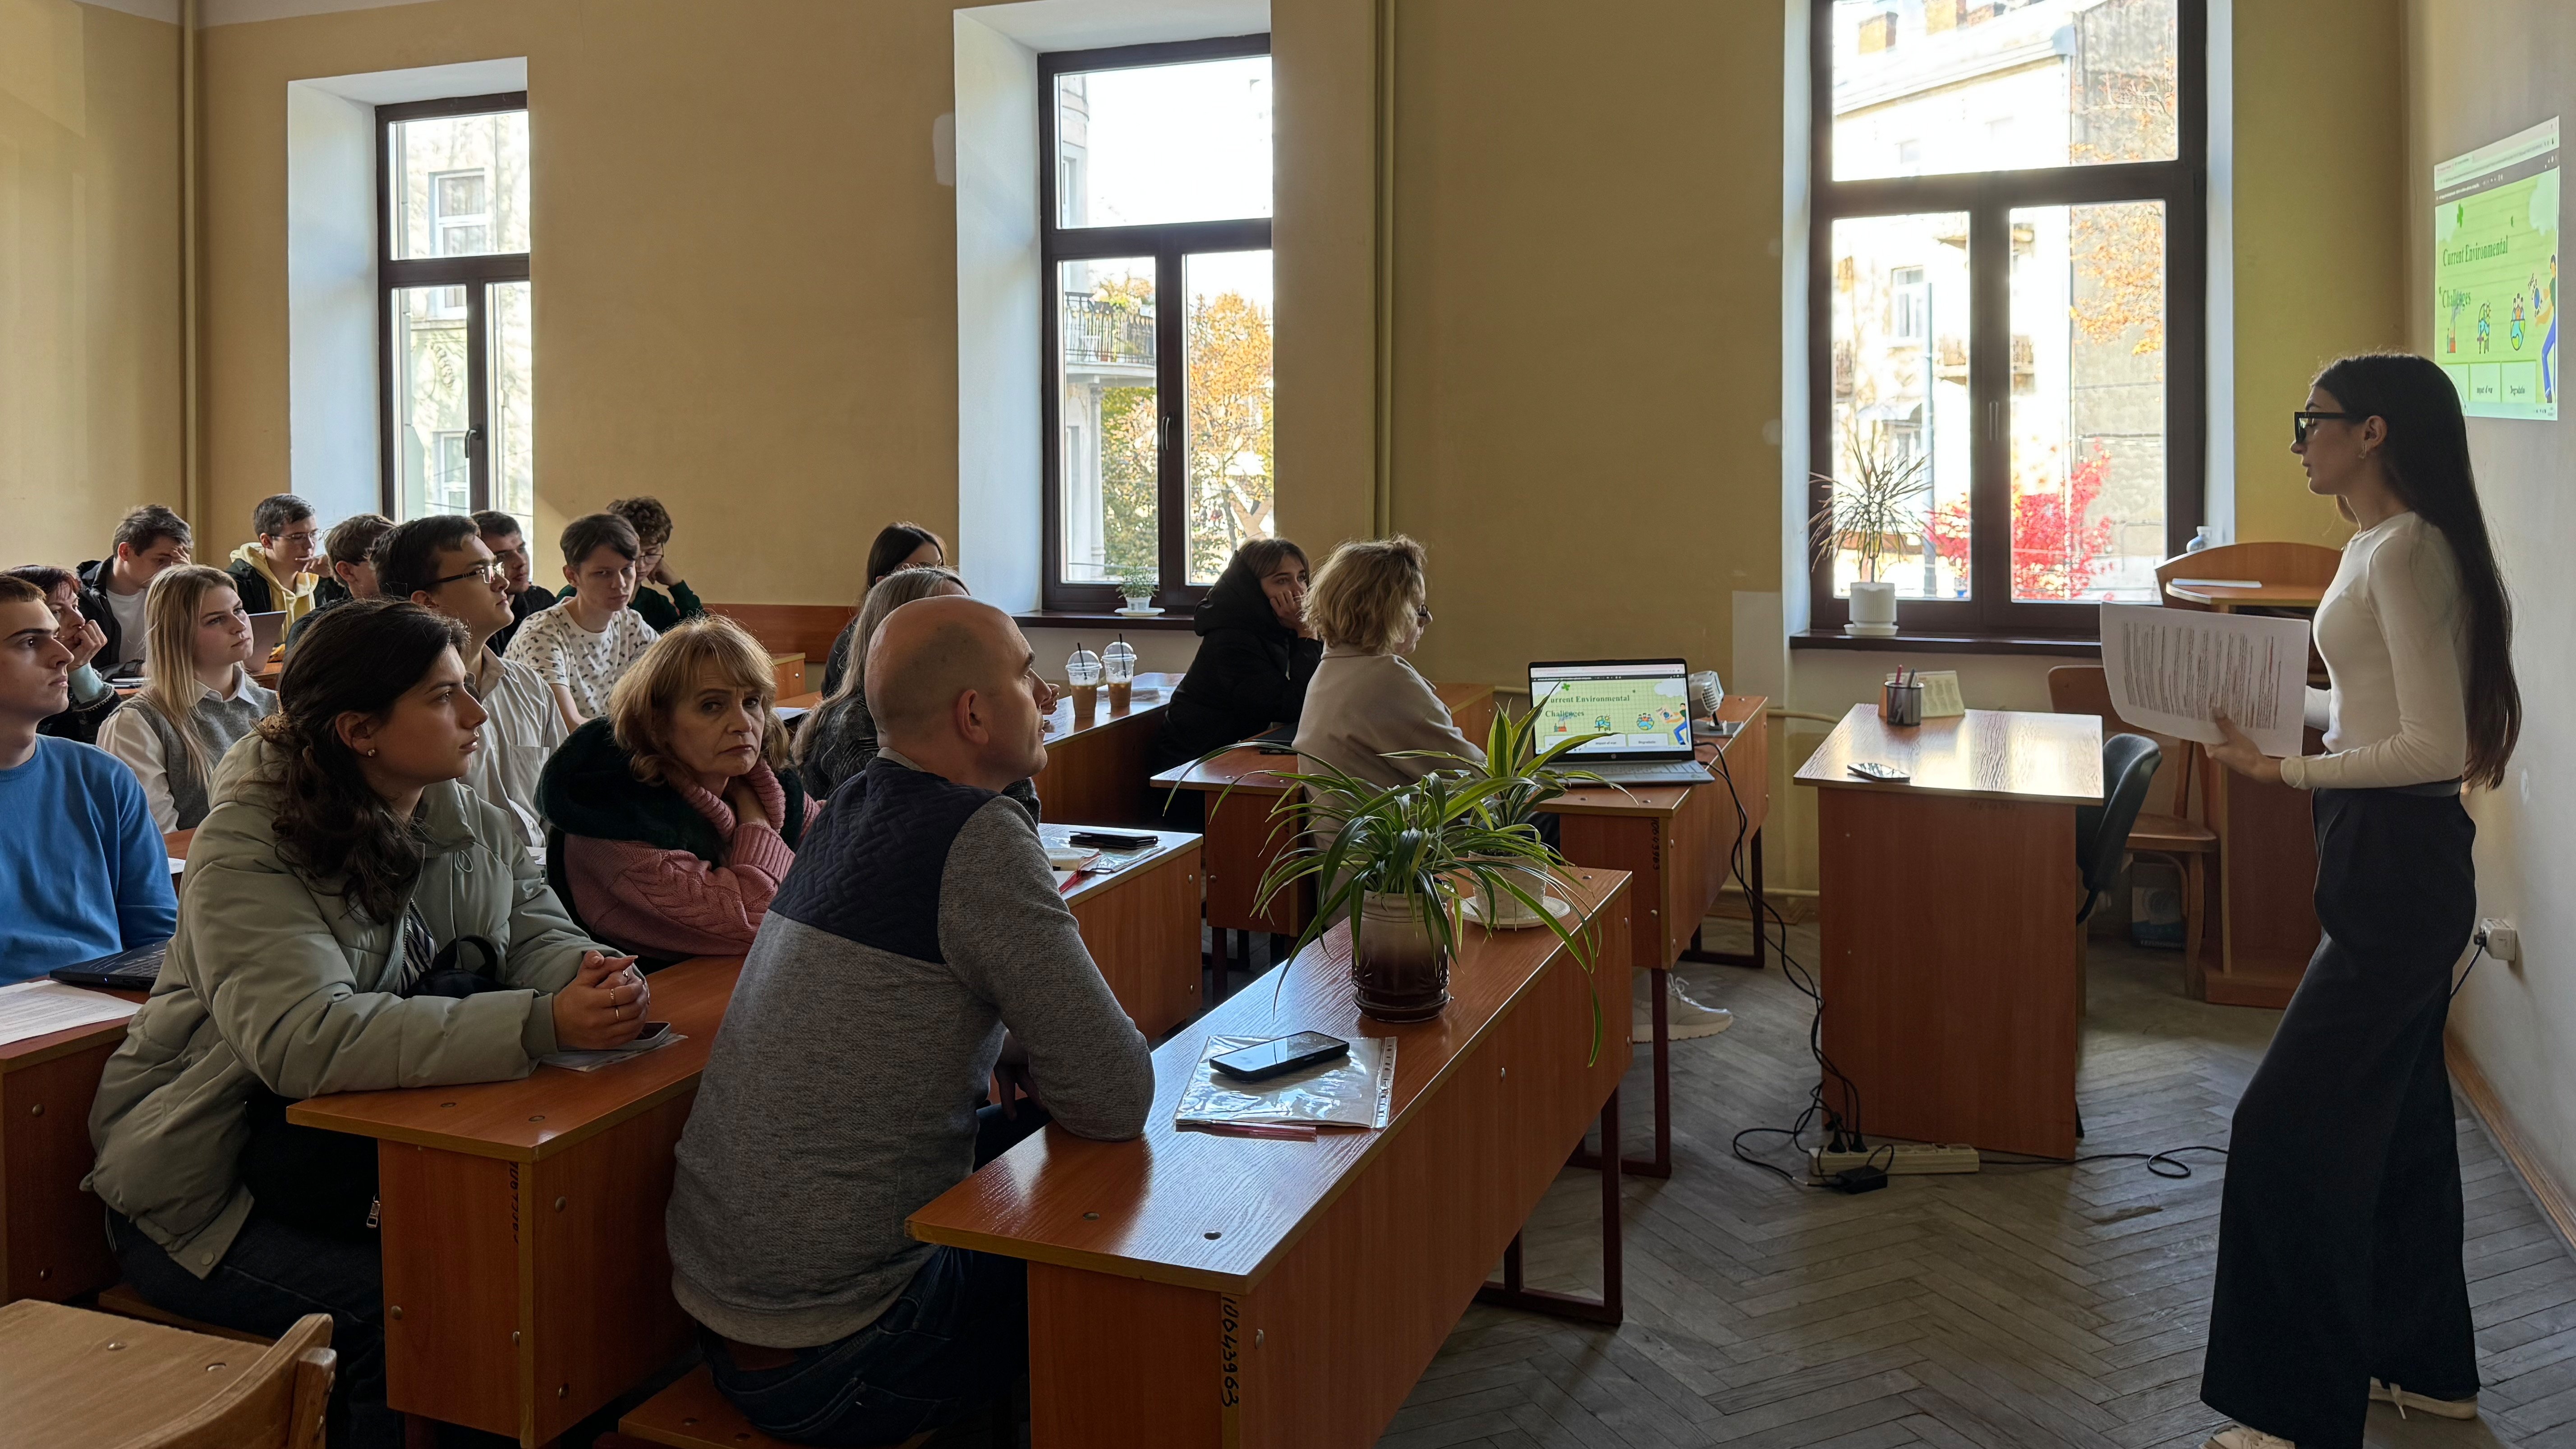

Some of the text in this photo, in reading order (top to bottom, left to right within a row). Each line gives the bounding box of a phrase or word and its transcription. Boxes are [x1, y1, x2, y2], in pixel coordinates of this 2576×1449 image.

[2443, 235, 2508, 267] Current Environmental
[1222, 1297, 1239, 1407] 10643963
